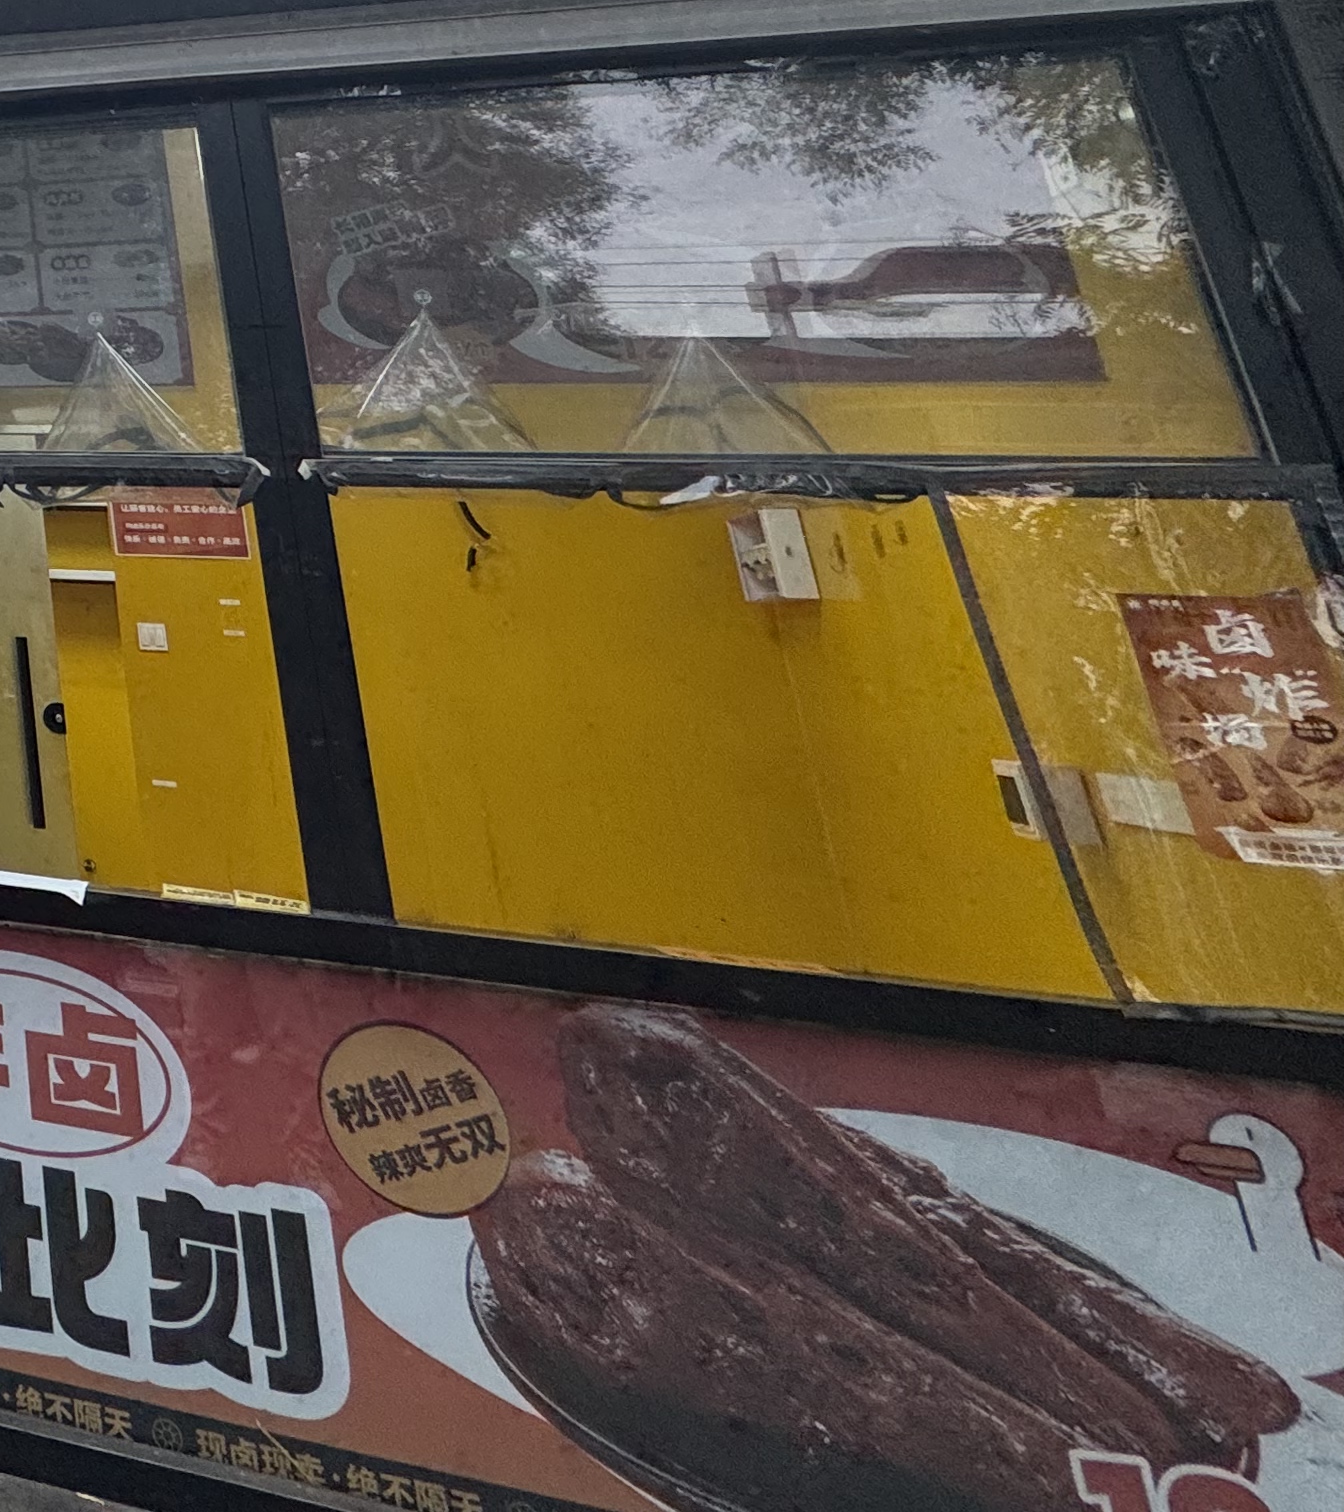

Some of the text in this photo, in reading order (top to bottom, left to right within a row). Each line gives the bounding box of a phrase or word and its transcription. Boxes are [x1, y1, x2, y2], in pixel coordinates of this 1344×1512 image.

[326, 1068, 479, 1134] 秘制卤香
[368, 1113, 507, 1185] 辣爽无双
